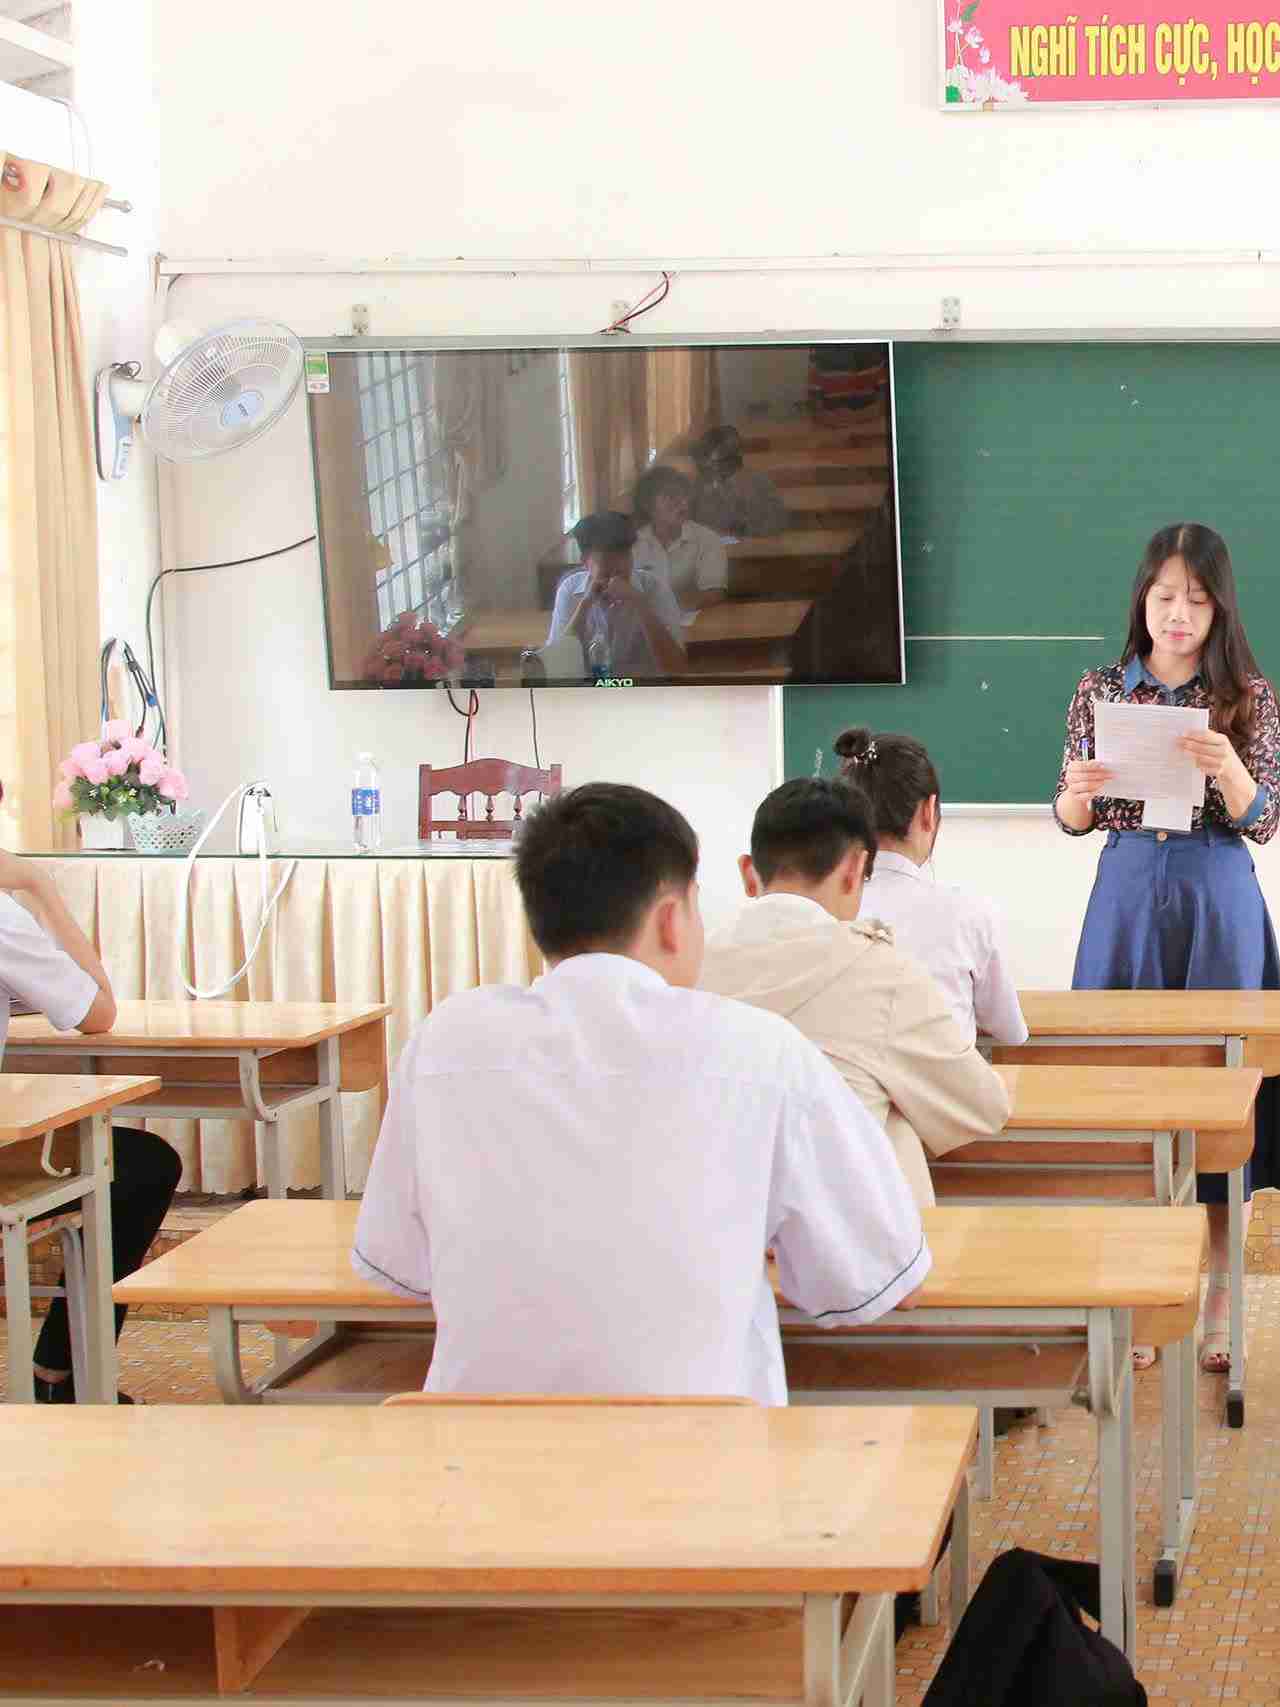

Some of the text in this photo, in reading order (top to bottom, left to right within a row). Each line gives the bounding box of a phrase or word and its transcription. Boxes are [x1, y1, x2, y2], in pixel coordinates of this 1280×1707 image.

[1010, 15, 1077, 77] NGHĨ
[1085, 14, 1146, 76] TÍCH
[1155, 18, 1219, 86] CỰC,
[595, 678, 634, 688] AIKYO
